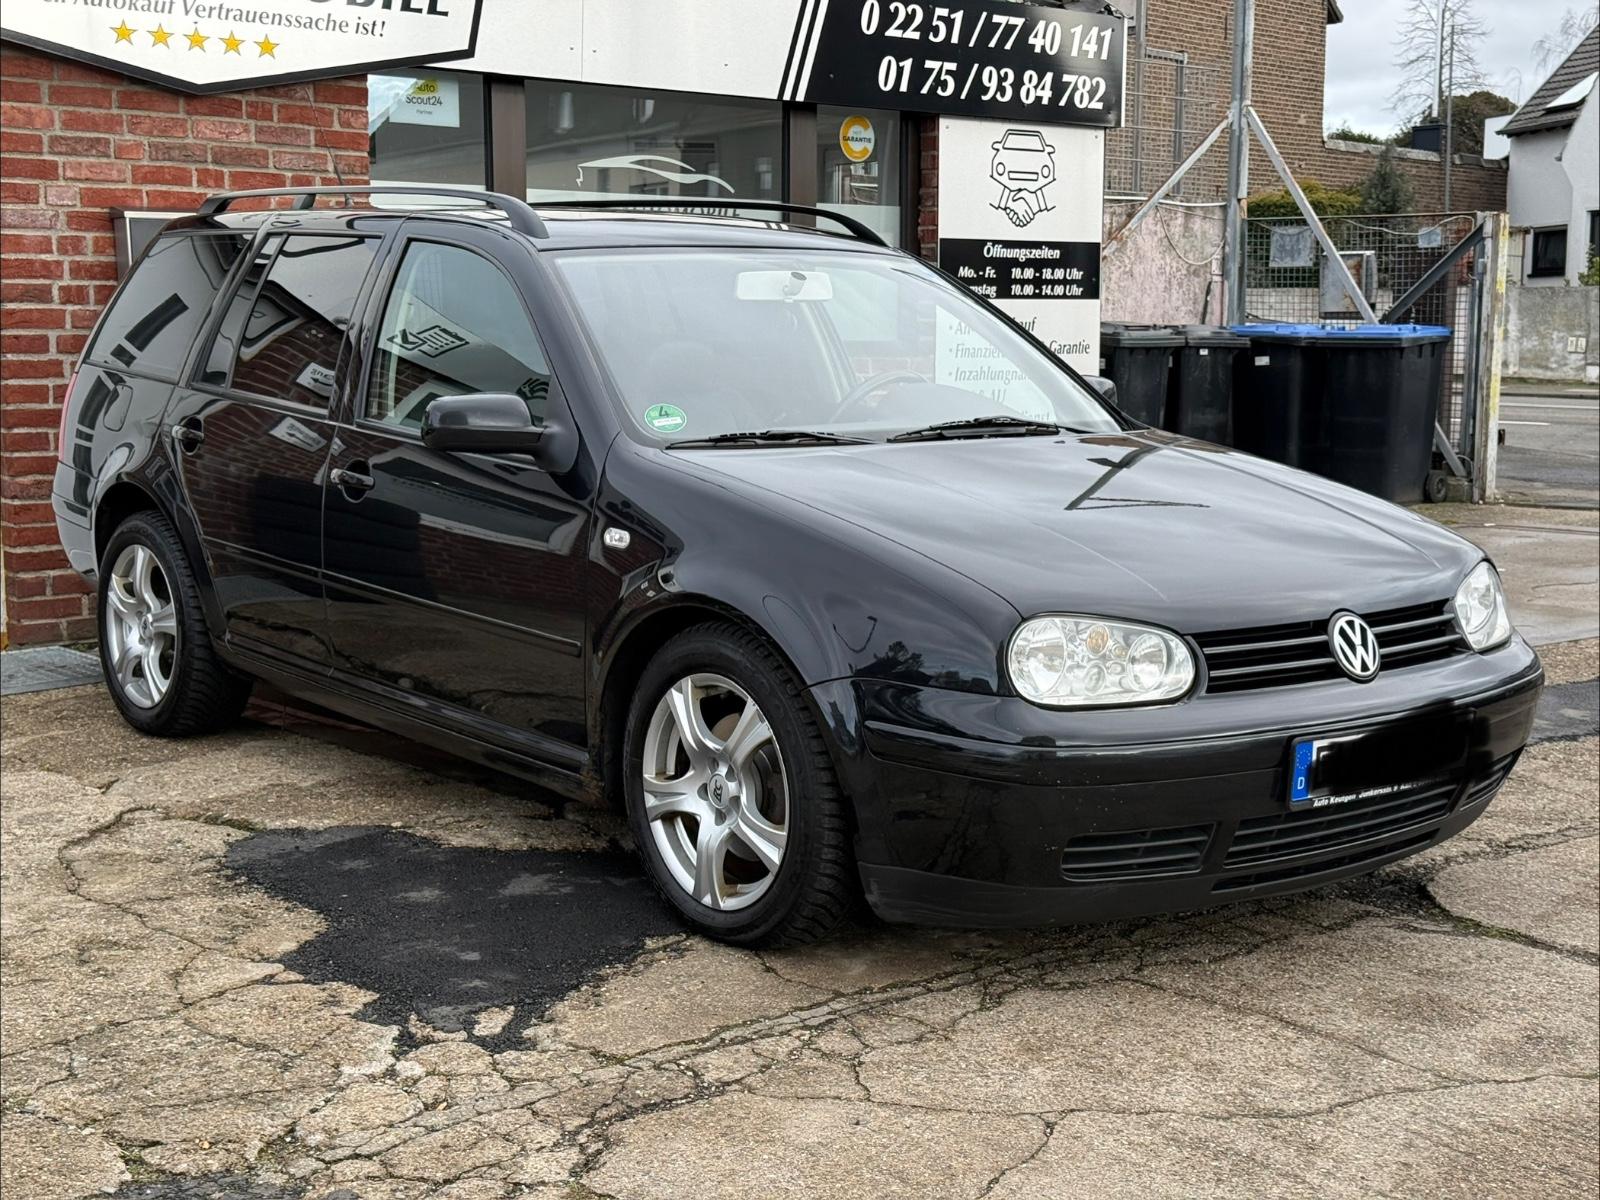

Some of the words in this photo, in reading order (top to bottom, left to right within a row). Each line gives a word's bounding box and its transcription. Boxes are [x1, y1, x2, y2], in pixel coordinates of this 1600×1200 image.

[73, 0, 175, 14] utokauf
[182, 0, 349, 33] Vertrauenssache
[355, 16, 386, 37] ist!
[860, 0, 880, 35] 0
[885, 2, 923, 40] 22
[929, 8, 964, 44] 51
[988, 15, 1025, 50] 77
[1028, 20, 1062, 56] 40
[1070, 24, 1113, 60] 141
[878, 56, 913, 92] 01
[920, 60, 957, 97] 75
[981, 66, 1014, 102] 93
[1020, 70, 1054, 105] 84
[1058, 74, 1106, 110] 782
[406, 95, 443, 106] Scout24
[843, 135, 872, 143] GARANTIE
[983, 242, 1061, 262] Öffnungszeiten
[958, 266, 977, 278] Mo.
[985, 266, 997, 278] Fr.
[1011, 268, 1034, 279] 10.00
[1041, 268, 1065, 280] 18.00
[1066, 268, 1083, 280] Uhr
[969, 284, 997, 298] mstag
[1010, 284, 1034, 296] 10.00
[1041, 284, 1065, 296] 14.00
[1066, 284, 1083, 296] Uhr
[954, 343, 1005, 358] Finanzier
[1050, 339, 1091, 355] Garantie
[954, 366, 1028, 386] Inzahlungna
[659, 406, 669, 417] 4
[1297, 777, 1306, 789] D
[1313, 798, 1328, 807] Auto
